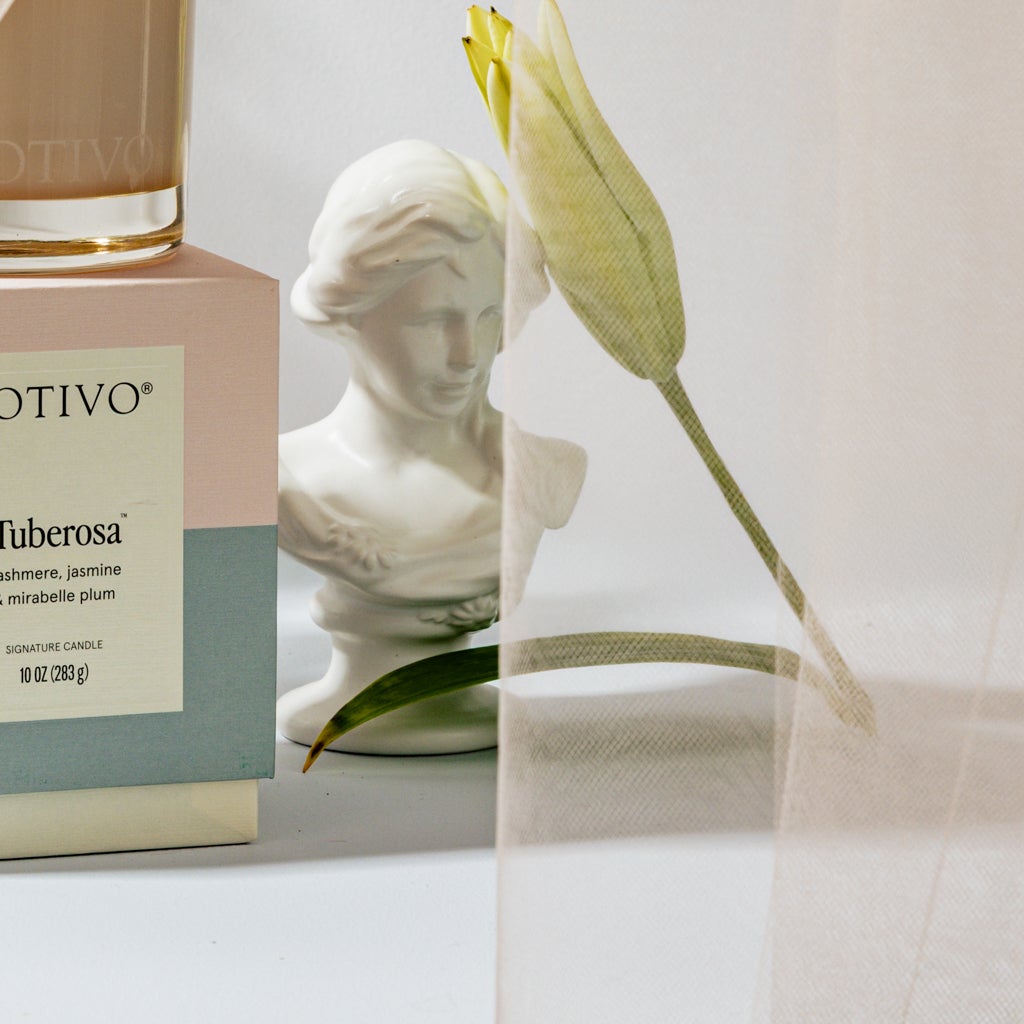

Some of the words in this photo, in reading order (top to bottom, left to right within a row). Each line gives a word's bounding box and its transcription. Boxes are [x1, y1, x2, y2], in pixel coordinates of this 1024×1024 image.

[67, 563, 121, 581] jasmine
[8, 589, 75, 605] mirabelle
[80, 588, 115, 604] plum
[6, 643, 60, 654] SIGNATURE
[64, 640, 102, 651] CANDLE
[20, 667, 31, 683] 10
[35, 666, 47, 682] OZ
[51, 664, 74, 683] (283
[77, 663, 88, 685] g)
